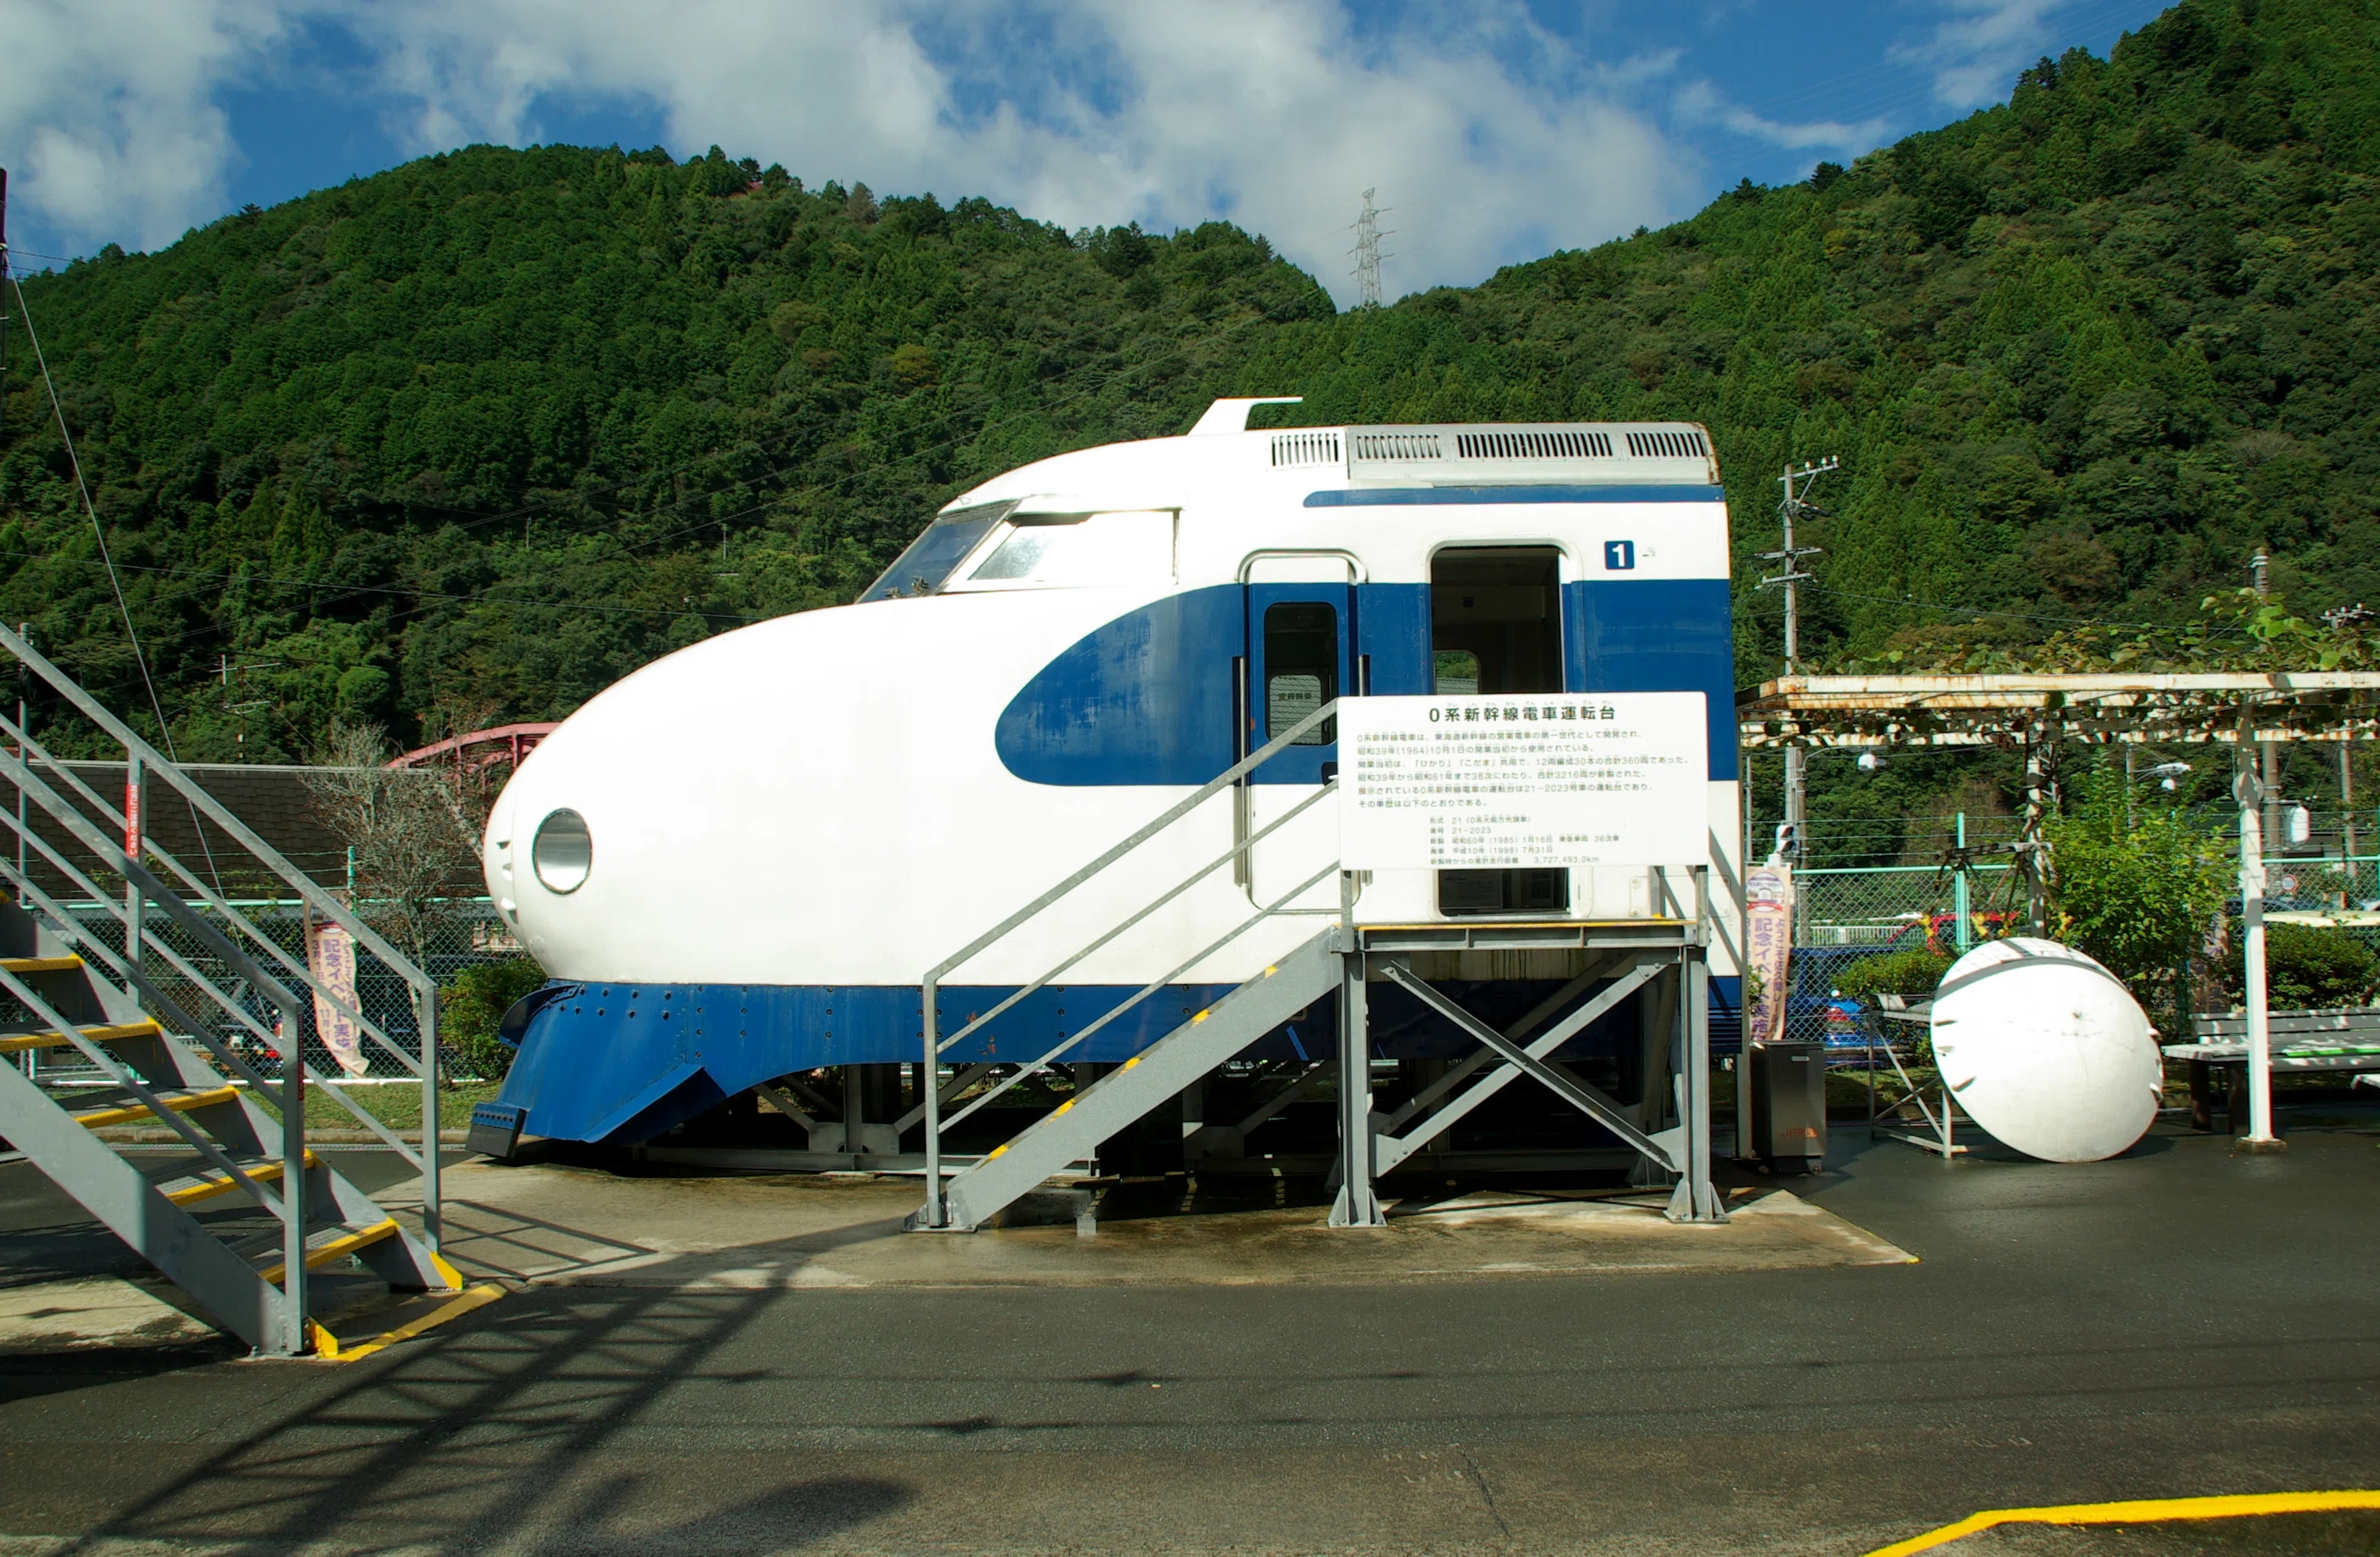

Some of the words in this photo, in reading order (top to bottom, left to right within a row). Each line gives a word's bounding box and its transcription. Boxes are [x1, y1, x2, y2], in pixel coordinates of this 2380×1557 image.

[1612, 543, 1626, 568] 1
[1429, 705, 1615, 722] 0系新幹線電車運転台
